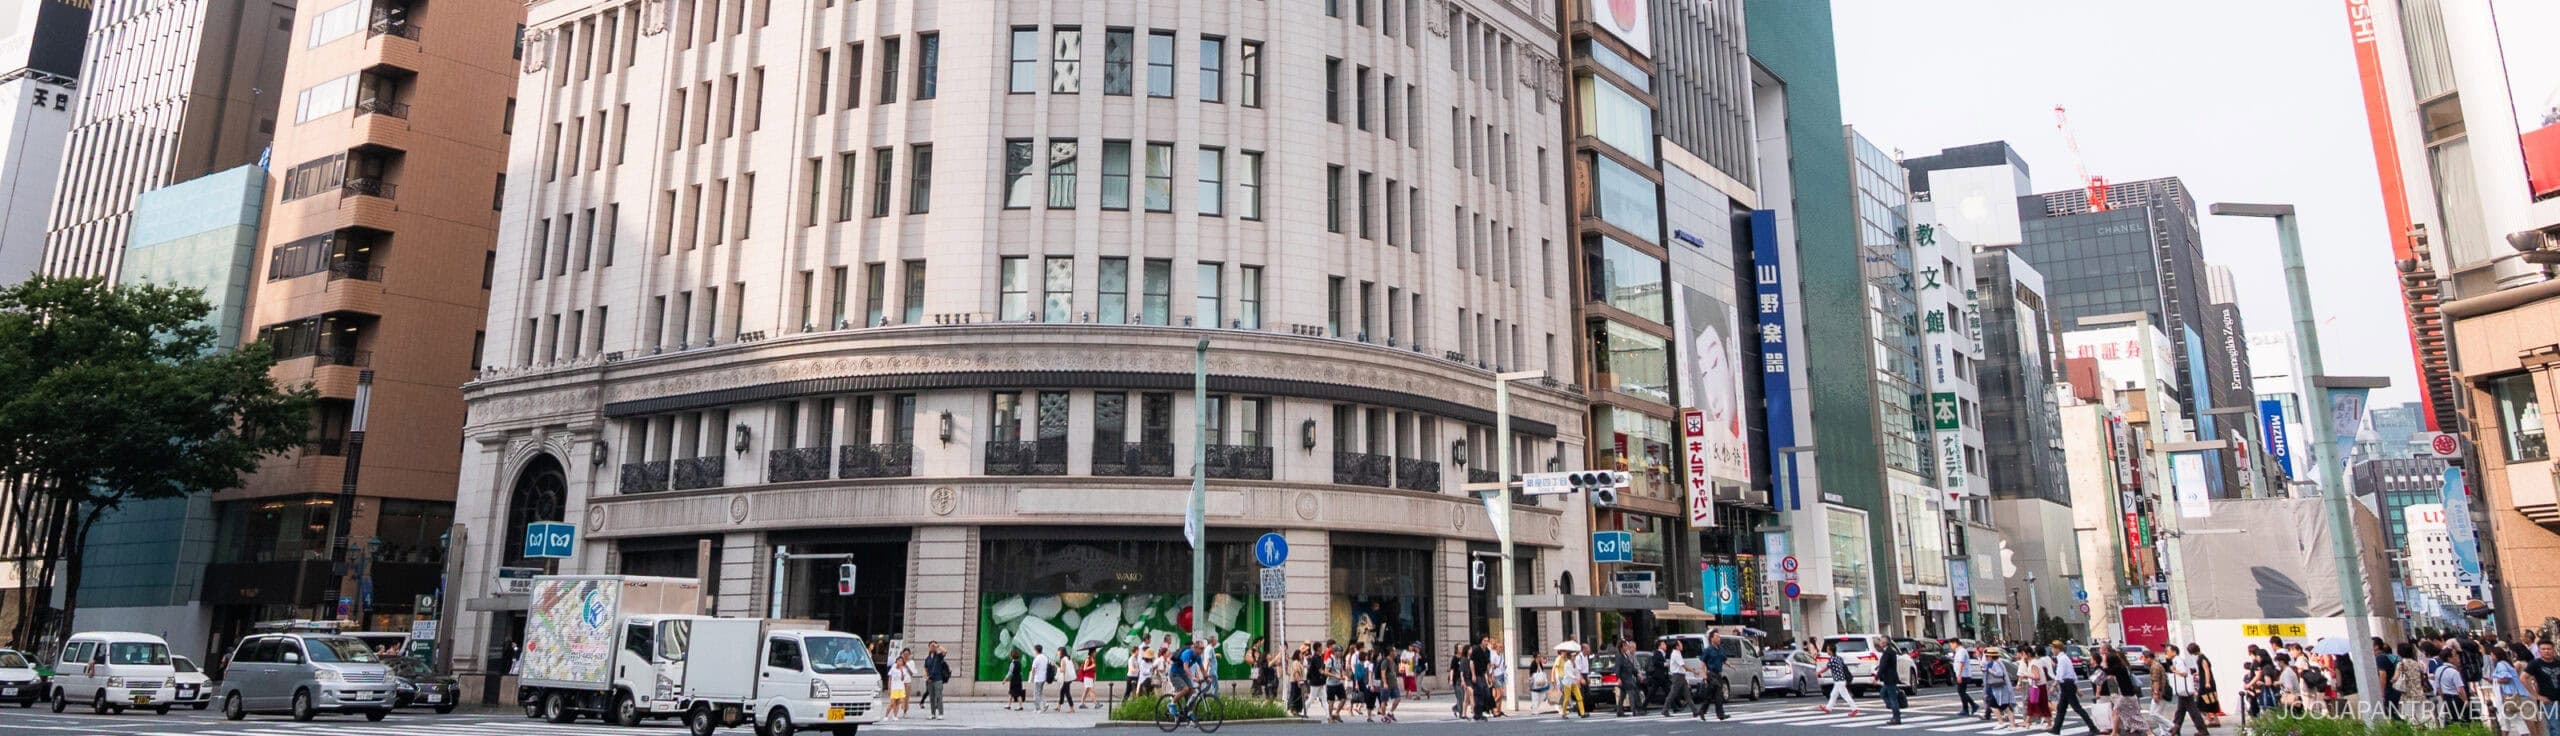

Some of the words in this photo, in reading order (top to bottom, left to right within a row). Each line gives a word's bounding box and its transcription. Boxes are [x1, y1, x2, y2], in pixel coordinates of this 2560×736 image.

[2097, 223, 2144, 235] CHANEL
[1915, 223, 1945, 334] 教文館
[1757, 265, 1784, 373] 山野楽器
[1966, 288, 1983, 353] 教文館ビル
[2222, 309, 2234, 336] Zegna
[2225, 336, 2242, 390] Ermenegildo
[1934, 398, 1956, 424] 本
[2270, 414, 2285, 457] MIZUHO
[1690, 441, 1708, 521] キムラヤのパン
[1115, 572, 1143, 582] WAKO
